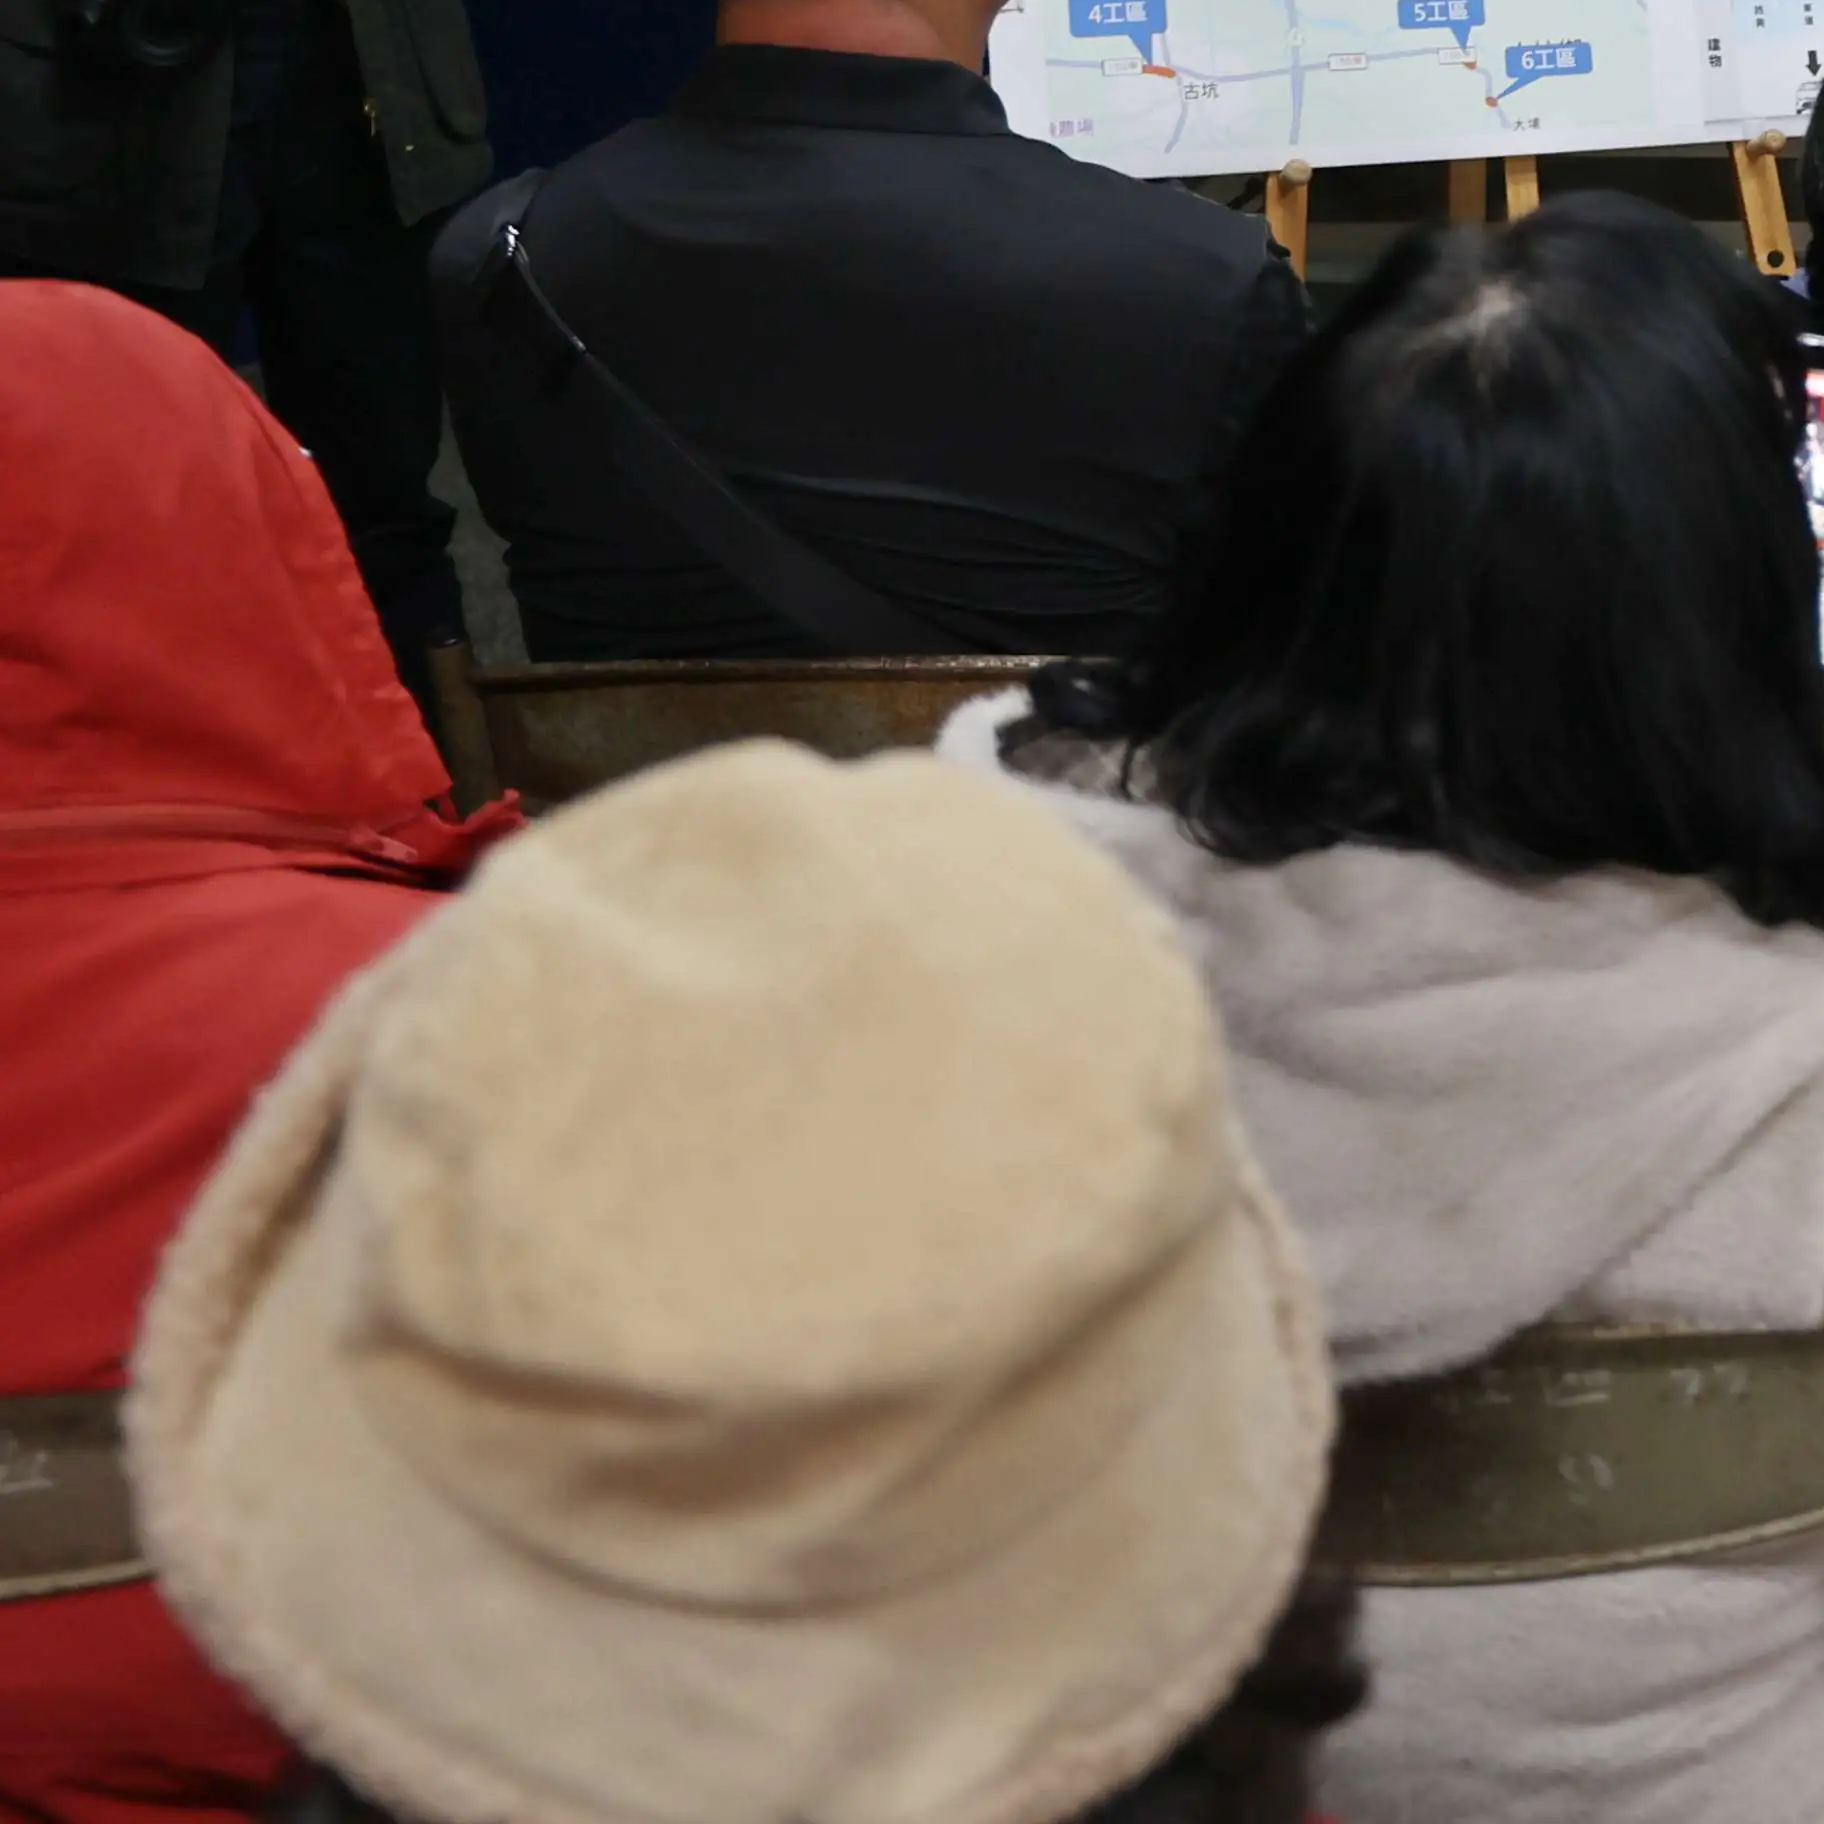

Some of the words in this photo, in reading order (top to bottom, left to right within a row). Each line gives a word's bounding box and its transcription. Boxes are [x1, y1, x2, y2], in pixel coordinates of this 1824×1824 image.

[1088, 1, 1148, 23] 4工區
[1414, 0, 1471, 22] 5工區
[1521, 47, 1577, 70] 6工區
[1184, 82, 1220, 101] 古坑
